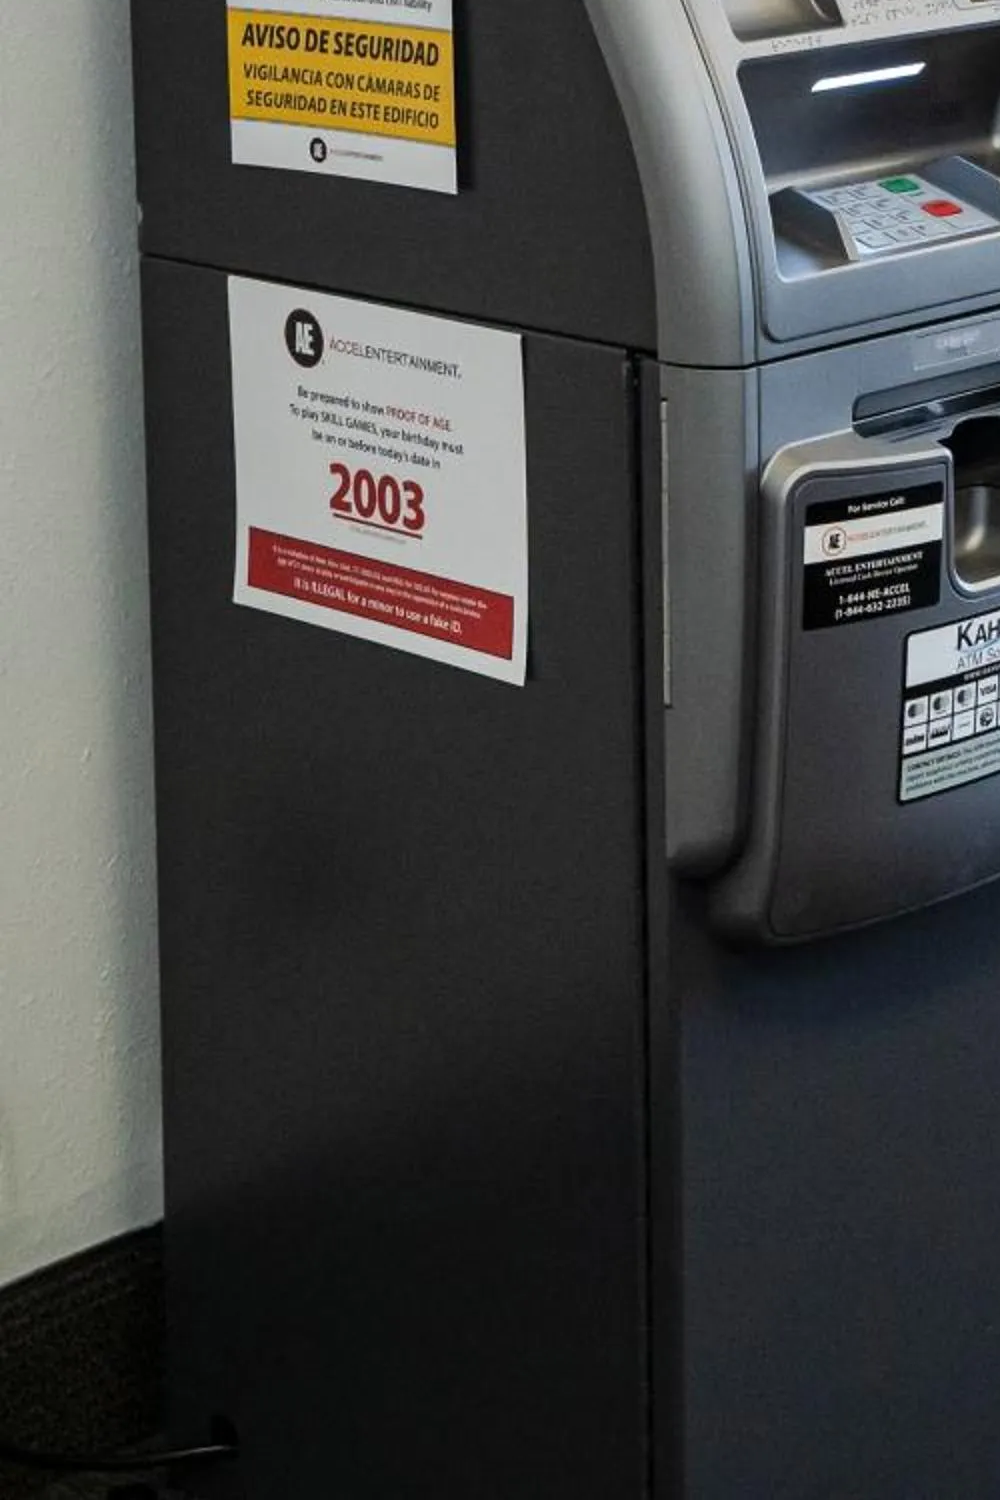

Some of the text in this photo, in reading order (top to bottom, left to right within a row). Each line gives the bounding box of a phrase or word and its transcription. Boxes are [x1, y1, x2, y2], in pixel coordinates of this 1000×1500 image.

[241, 23, 440, 68] AVISO DE SEGURIDAD
[243, 63, 323, 87] VIGILANCIA
[325, 71, 354, 90] CON
[423, 84, 441, 103] DE
[246, 89, 439, 130] SEGURIDAD EN ESTE EDIFICIO
[297, 385, 308, 399] Be
[310, 390, 349, 409] prepared
[351, 398, 360, 410] to
[362, 400, 384, 416] show
[386, 405, 415, 423] PROOF
[418, 413, 431, 426] OF
[289, 403, 300, 417] To
[302, 406, 319, 422] play
[321, 411, 344, 428] SKILL
[380, 426, 401, 439] your
[402, 428, 440, 452] birthday
[442, 440, 464, 454] must
[311, 428, 323, 441] be
[325, 433, 336, 443] on
[338, 435, 347, 446] or
[349, 436, 377, 455] before
[411, 452, 430, 467] date
[432, 459, 441, 470] in
[329, 463, 425, 530] 2003
[848, 505, 861, 514] For
[862, 500, 888, 511] Service
[825, 550, 924, 577] ACCEL ENTERTAINMENT
[302, 580, 309, 592] is
[311, 580, 346, 603] ILLEGAL
[347, 592, 359, 605] for
[361, 598, 367, 608] a
[368, 599, 393, 614] minor
[395, 605, 404, 618] to
[406, 609, 422, 623] use
[423, 614, 429, 625] a
[430, 613, 449, 630] fake
[957, 653, 983, 672] ATM
